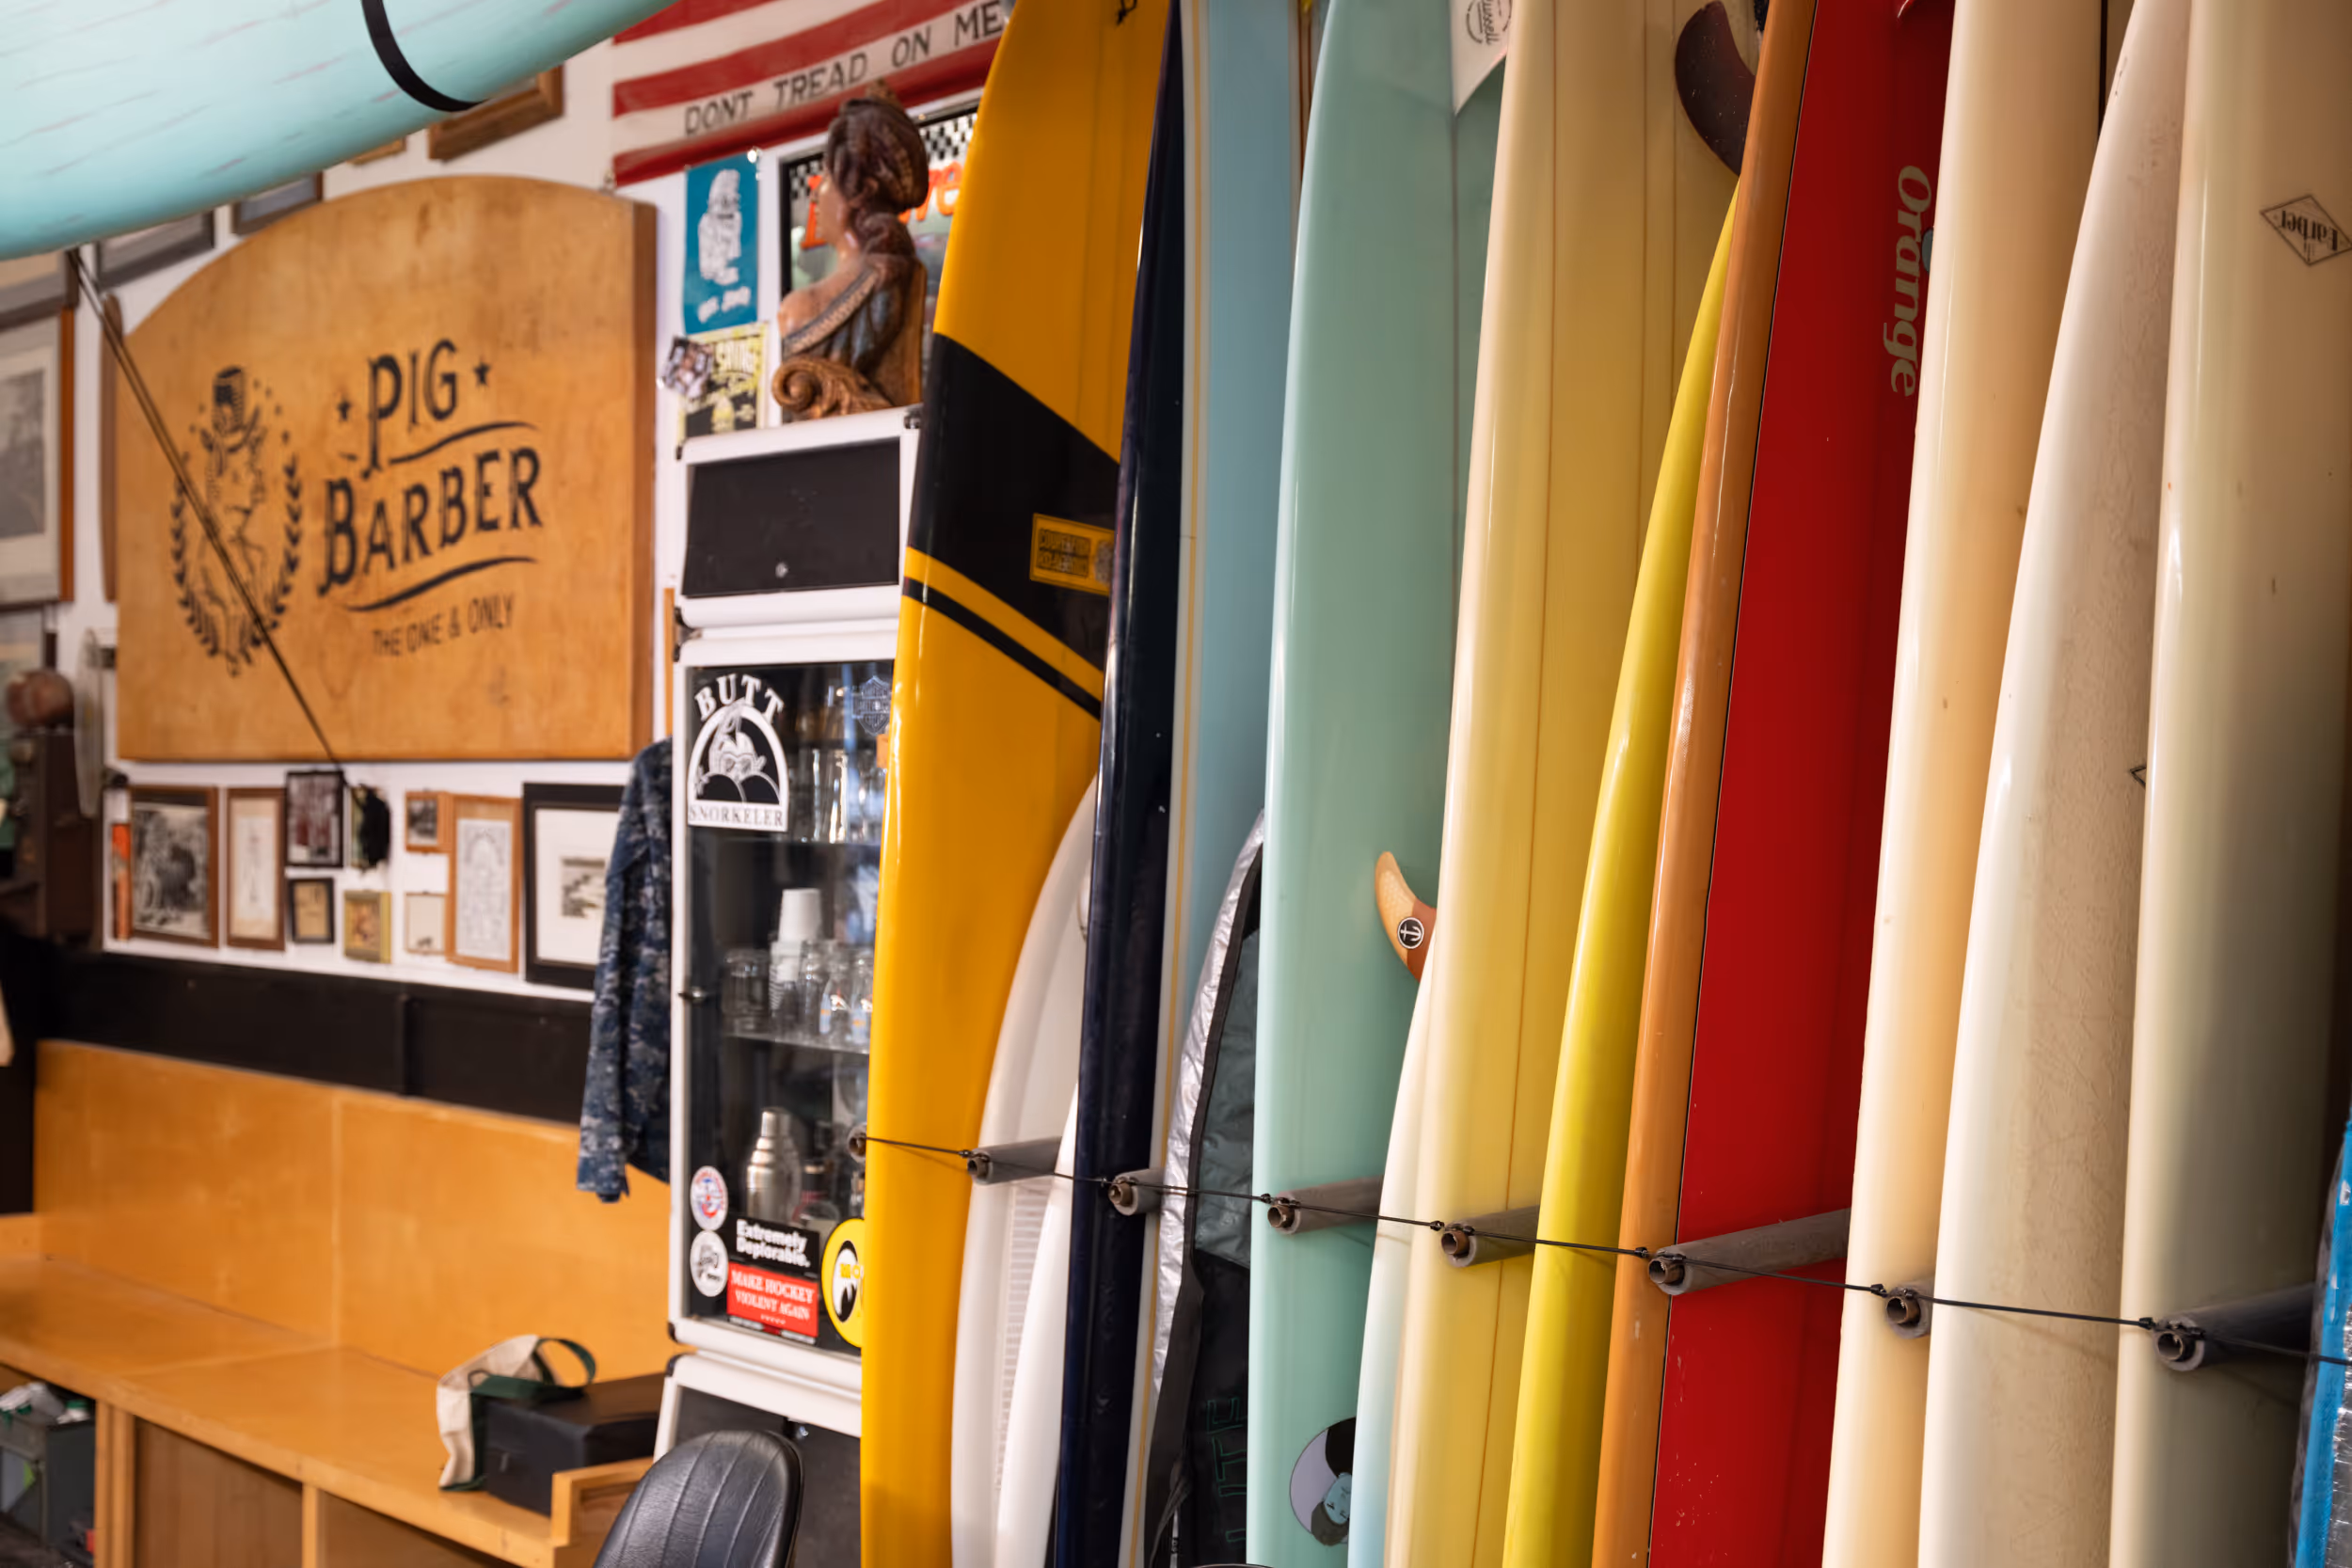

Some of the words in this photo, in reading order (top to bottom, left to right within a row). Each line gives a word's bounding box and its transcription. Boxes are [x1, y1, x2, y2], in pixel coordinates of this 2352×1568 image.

[1482, 0, 1500, 45] ussell
[684, 90, 754, 137] DONT
[772, 52, 867, 111] TREAD
[891, 25, 931, 69] ON
[954, 1, 1004, 46] ME
[1883, 166, 1931, 396] Orange
[360, 339, 458, 481] PIG
[317, 447, 542, 597] BARBER
[372, 627, 402, 657] THE
[406, 613, 443, 657] ONE
[449, 607, 462, 641] &
[468, 594, 516, 635] ONLY
[694, 673, 784, 723] BUTT
[689, 805, 783, 828] SNORKELER
[736, 1219, 808, 1254] Extremely
[730, 1270, 763, 1291] MAKE
[765, 1276, 816, 1305] HOCKEY
[735, 1289, 778, 1313] VIOLENT
[780, 1302, 811, 1321] AGAIN
